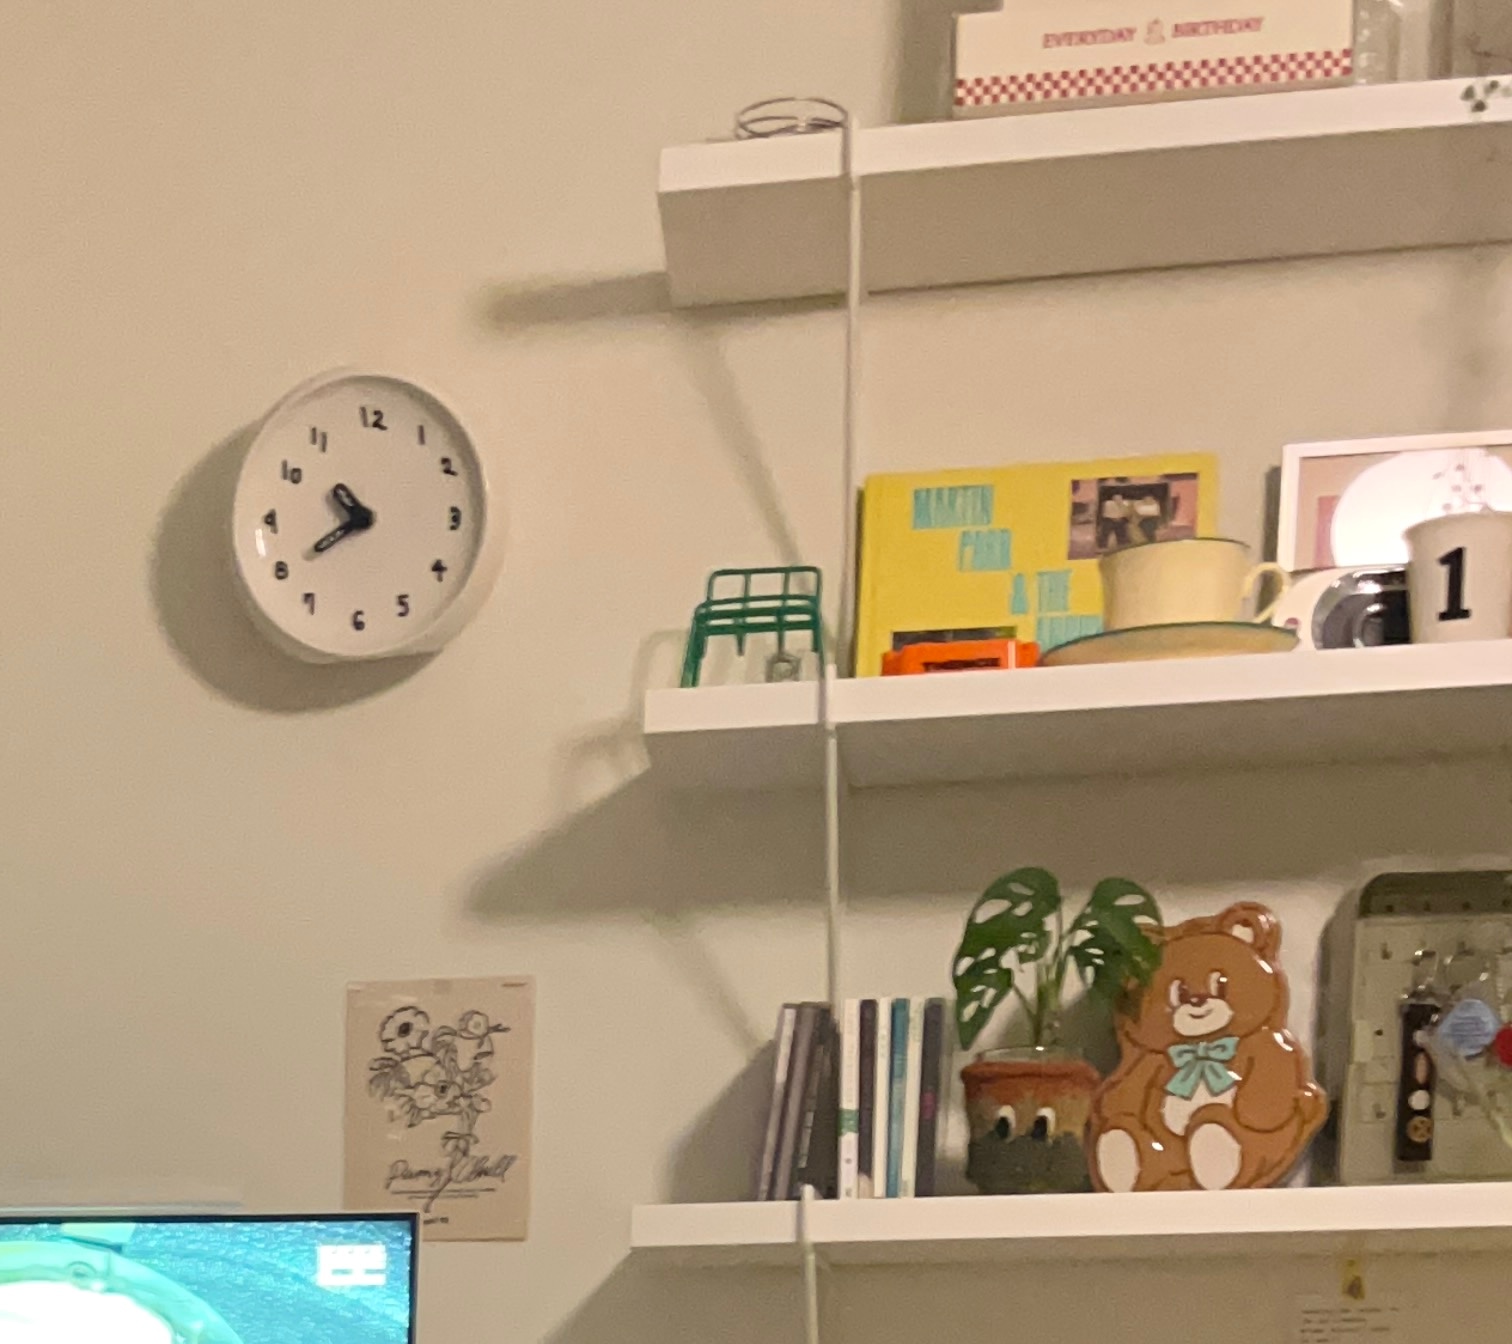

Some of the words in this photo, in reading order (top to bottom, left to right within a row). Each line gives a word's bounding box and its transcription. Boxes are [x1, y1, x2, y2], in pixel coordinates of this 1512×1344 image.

[1042, 27, 1137, 49] EVERYDAY
[1171, 16, 1265, 38] BIRTHDAY
[360, 406, 387, 431] 12
[310, 426, 328, 453] 11
[418, 424, 425, 446] 1
[281, 459, 302, 485] 10
[440, 457, 458, 477] 2
[263, 508, 278, 534] 9
[449, 506, 461, 530] 3
[274, 561, 289, 580] 8
[431, 558, 448, 582] 4
[1438, 546, 1472, 622] 1
[302, 592, 315, 615] 7
[396, 594, 410, 617] 5
[352, 610, 365, 631] 6
